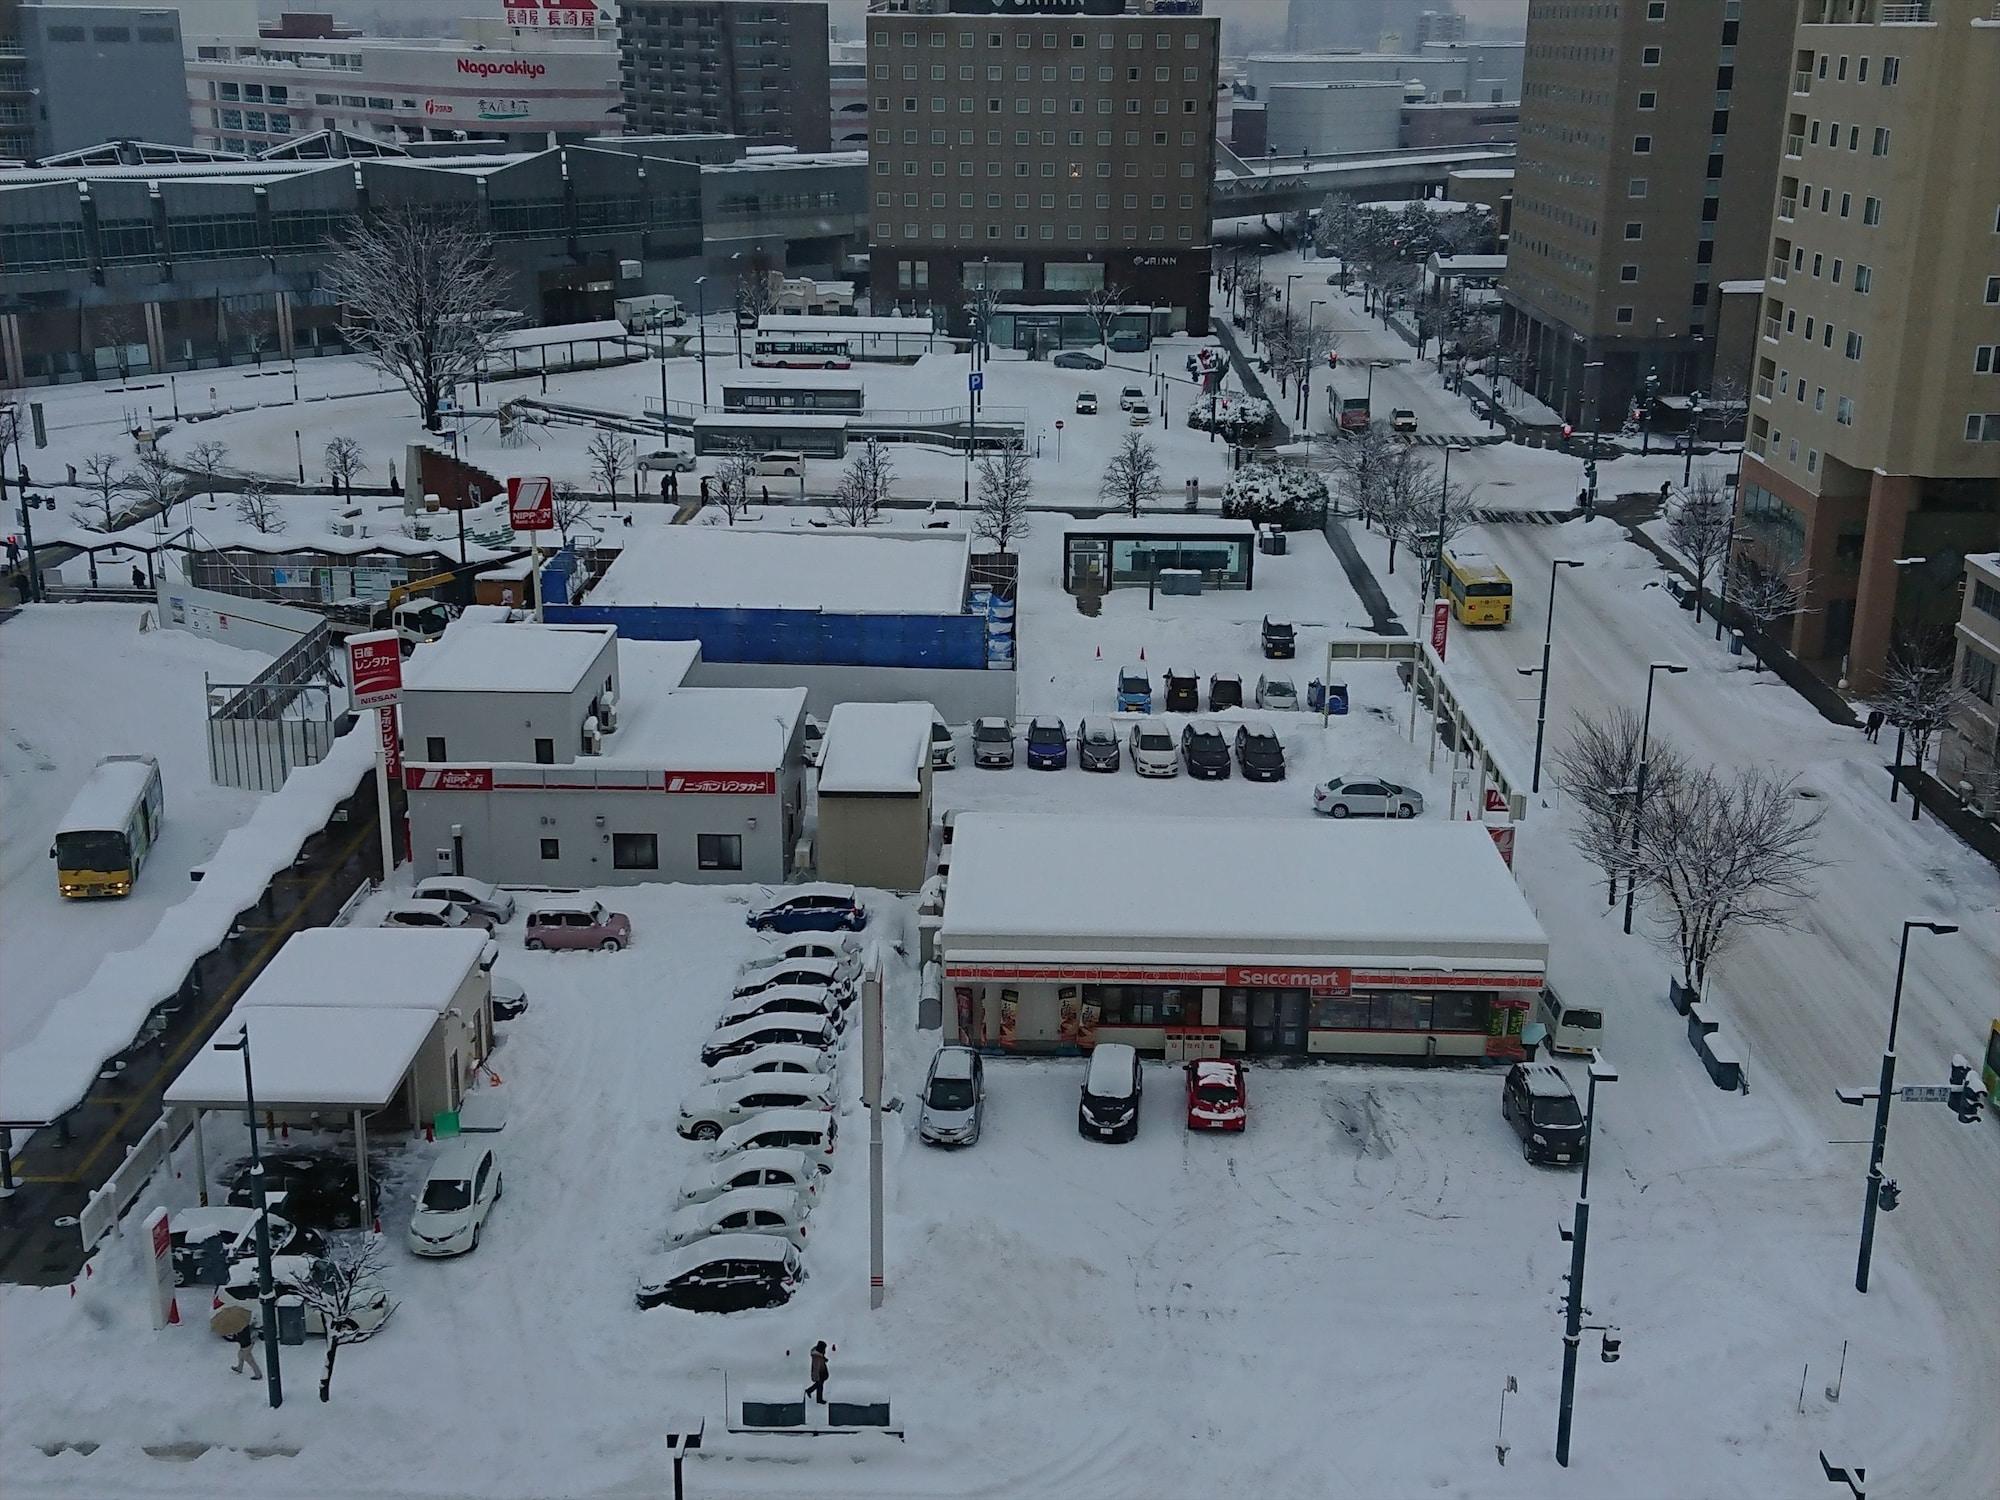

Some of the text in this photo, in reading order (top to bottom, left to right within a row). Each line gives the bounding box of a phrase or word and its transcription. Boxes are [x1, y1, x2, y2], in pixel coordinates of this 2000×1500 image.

[507, 10, 539, 25] 長崎屋
[547, 10, 595, 26] 長崎屋
[457, 59, 546, 78] Nagasakiya
[972, 376, 980, 389] P
[354, 647, 373, 659] 日産
[355, 656, 397, 670] レンタカー
[360, 693, 398, 705] NISSAN
[684, 780, 766, 792] ニッポンレンタカー
[1239, 969, 1339, 986] Seicomart
